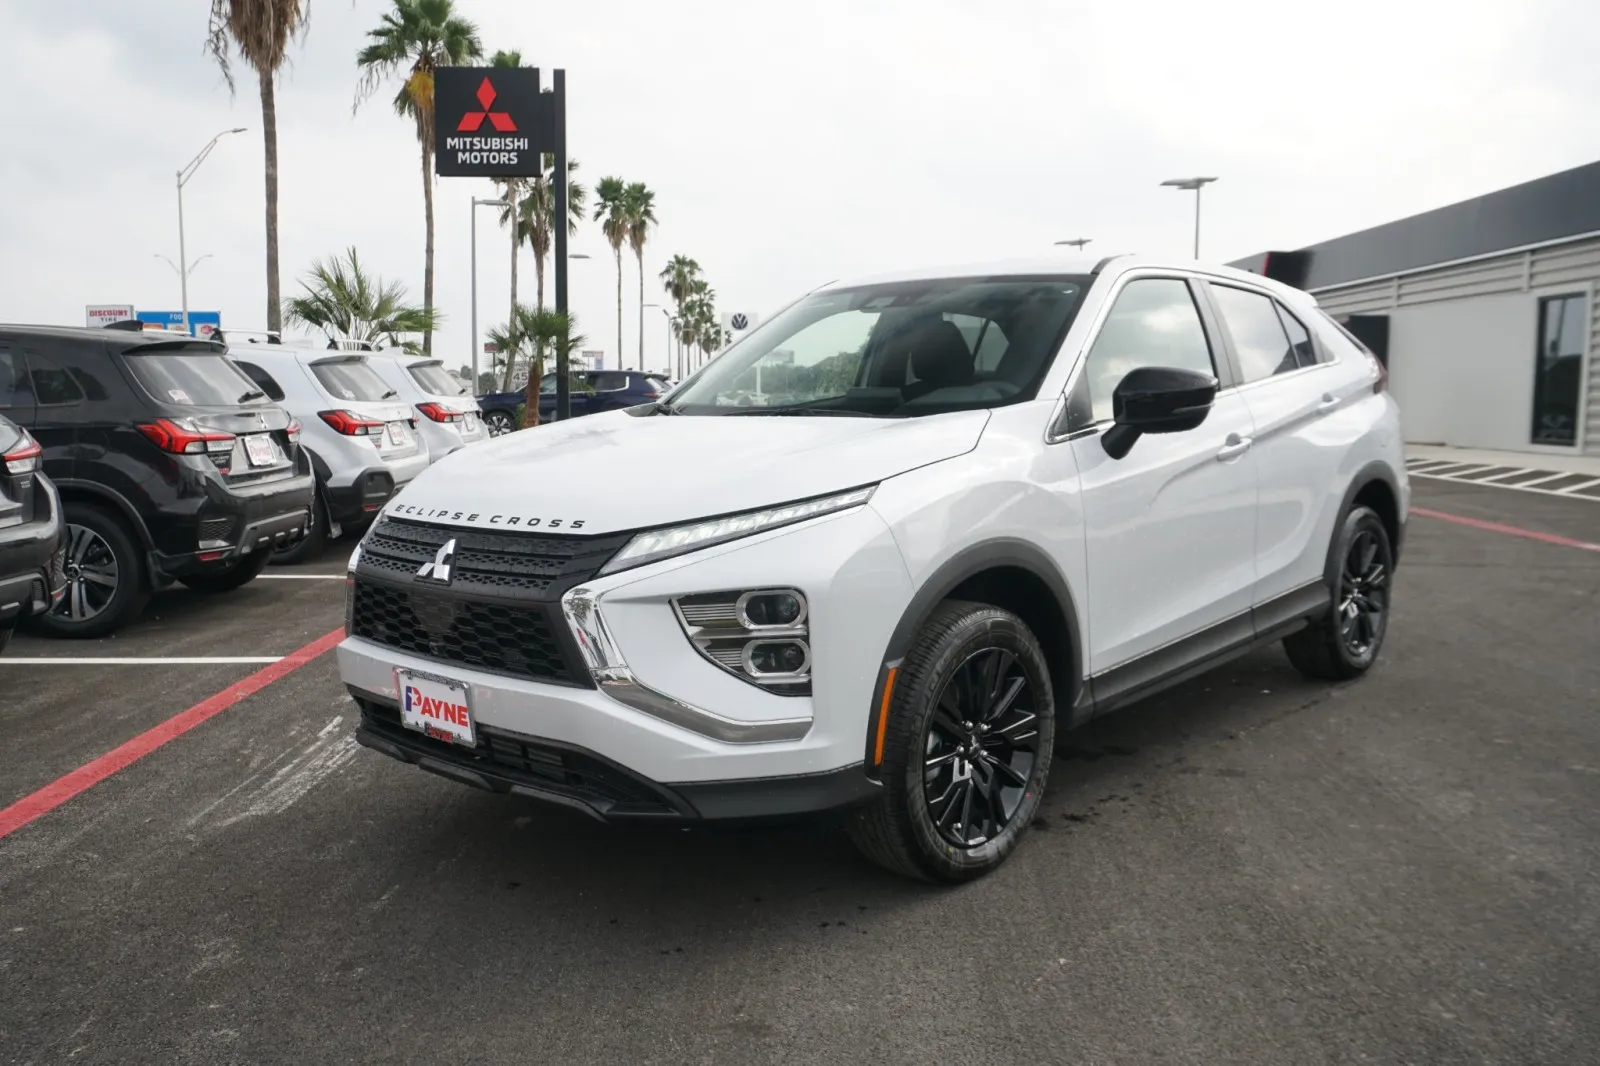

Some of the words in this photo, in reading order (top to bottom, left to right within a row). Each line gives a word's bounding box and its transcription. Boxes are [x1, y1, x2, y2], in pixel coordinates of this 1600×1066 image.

[446, 137, 528, 150] MITSUBISHI
[457, 151, 518, 164] MOTORS
[89, 309, 128, 317] DISCOUNT
[169, 313, 186, 321] FOO
[513, 372, 528, 381] 45
[394, 504, 480, 522] ECLIPSE
[489, 515, 586, 529] CROSS
[405, 685, 468, 727] PAYNE
